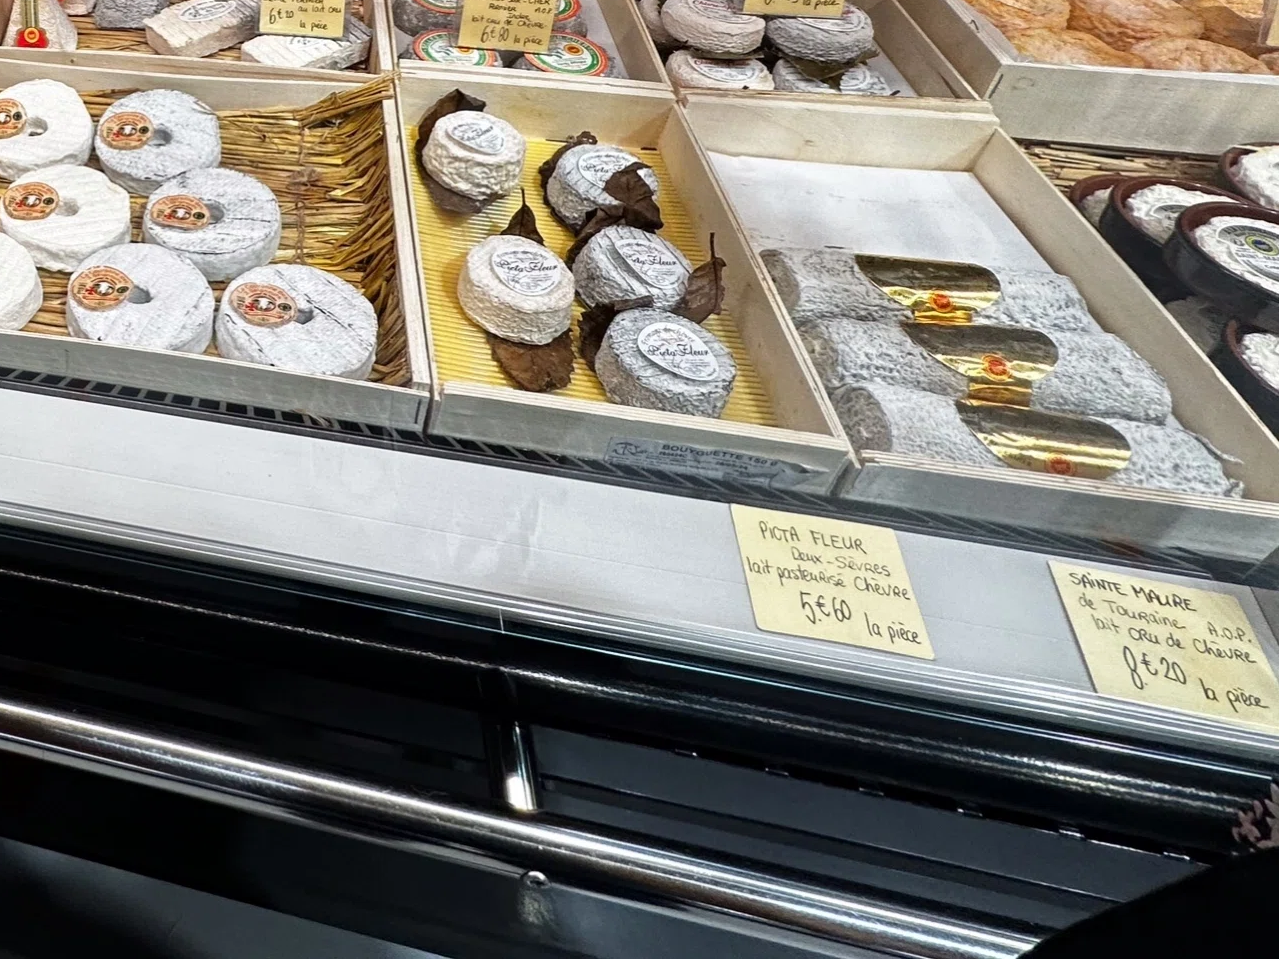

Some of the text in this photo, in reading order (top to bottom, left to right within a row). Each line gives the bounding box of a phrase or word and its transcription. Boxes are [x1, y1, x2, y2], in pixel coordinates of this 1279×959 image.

[809, 529, 868, 555] FLEUR
[746, 556, 774, 575] lait
[1078, 592, 1097, 611] de
[1130, 584, 1198, 613] MAURE
[863, 612, 883, 638] la
[1090, 613, 1120, 634] lait
[1166, 633, 1186, 650] de
[1198, 677, 1219, 702] la
